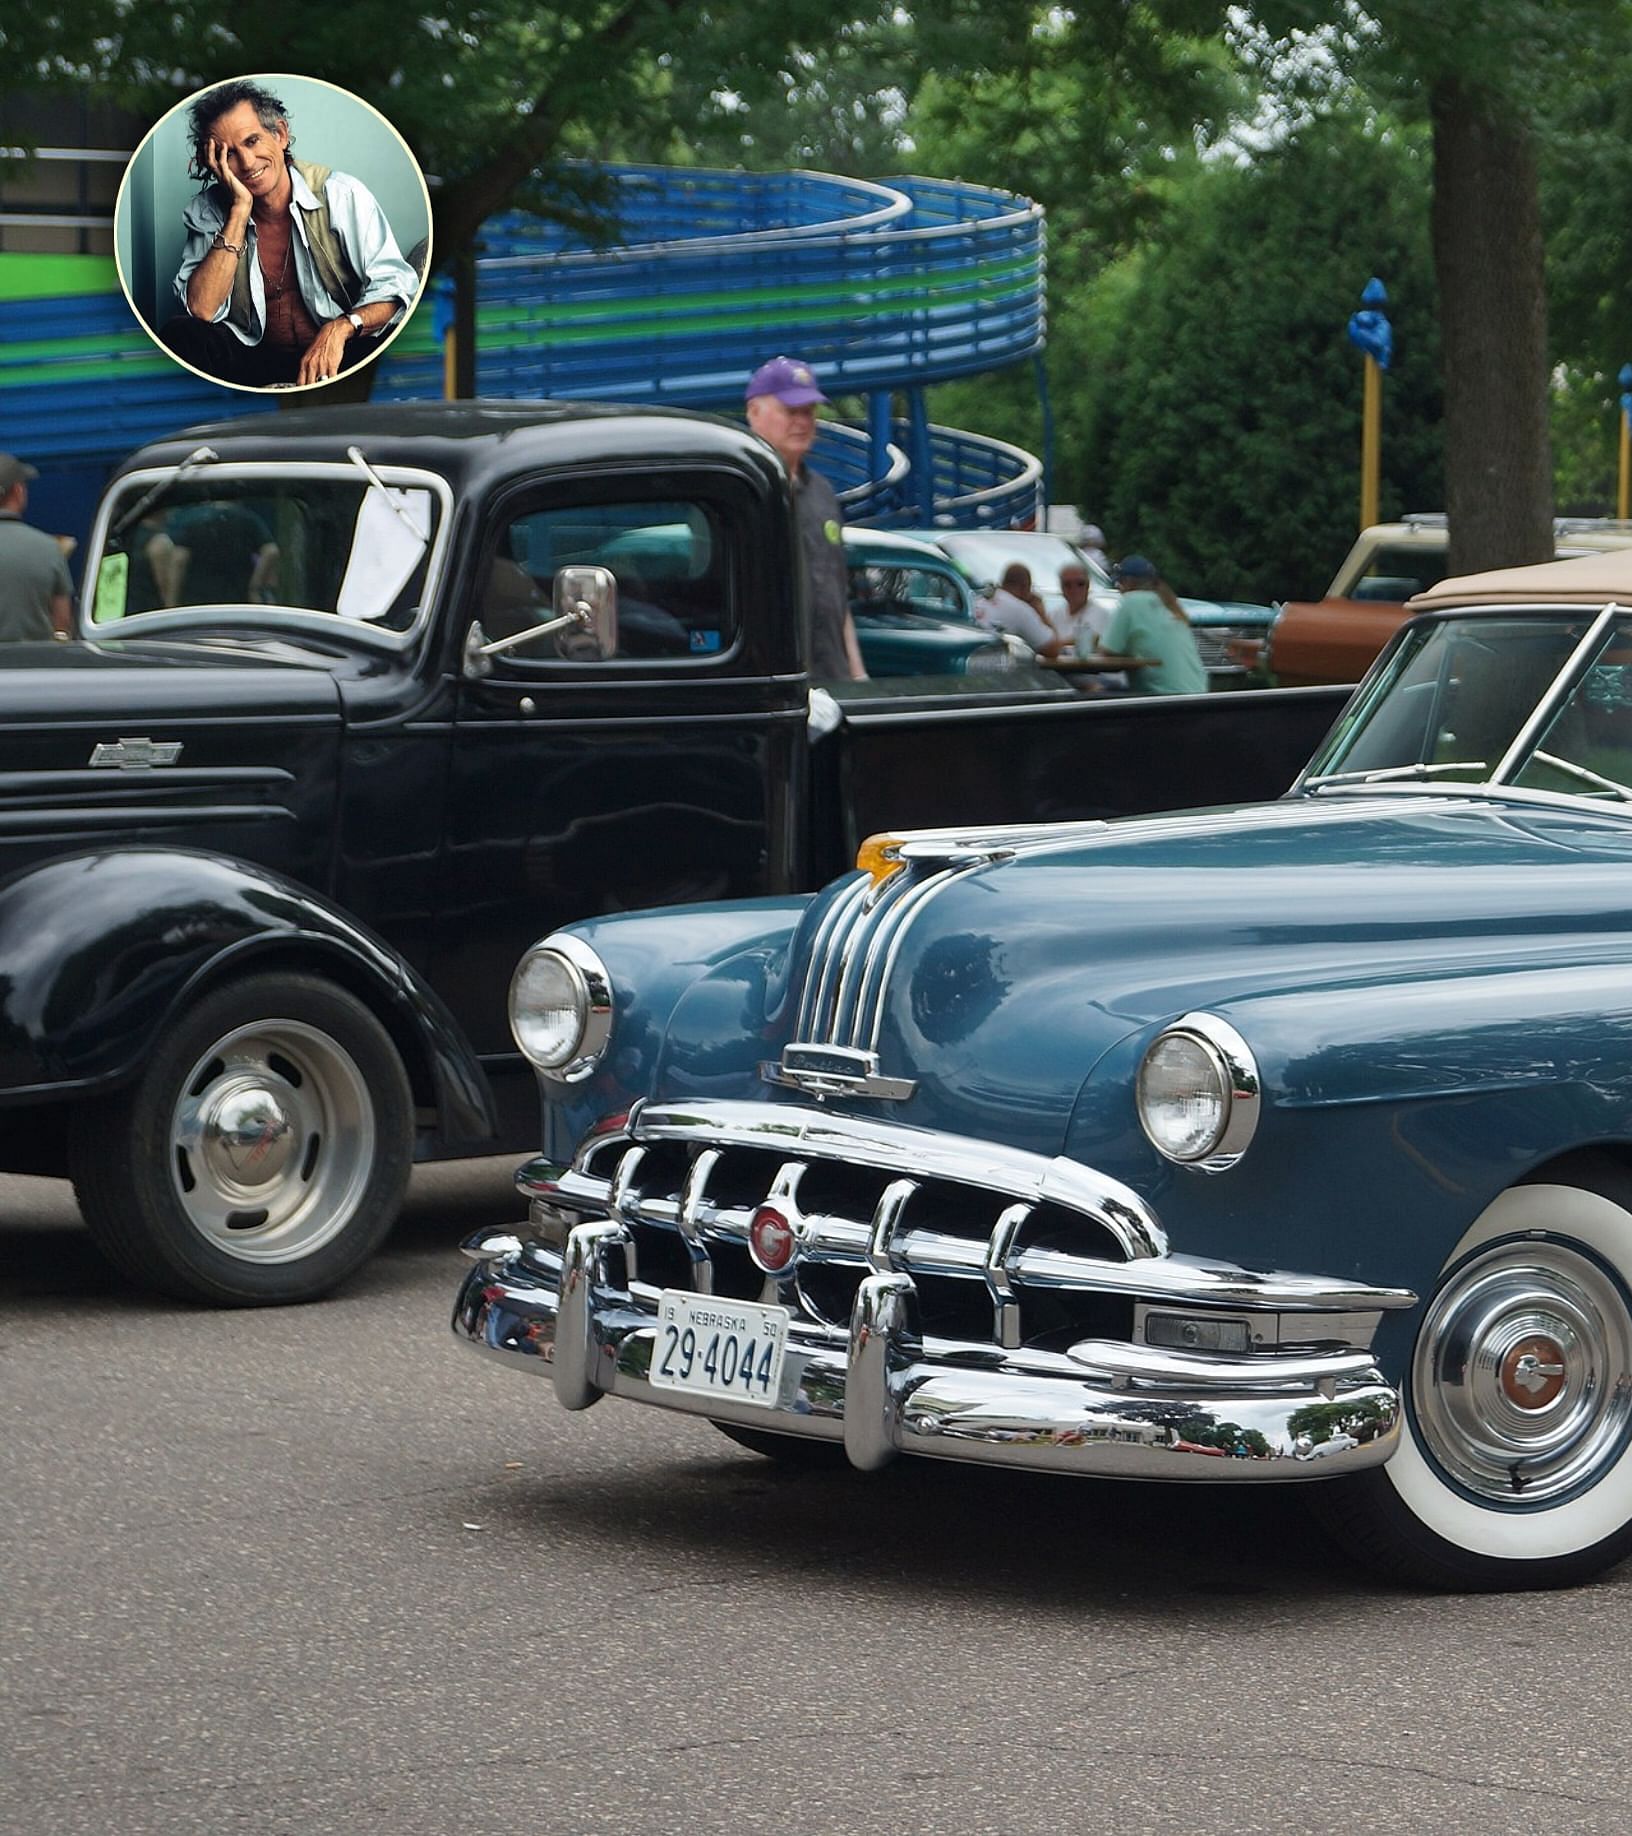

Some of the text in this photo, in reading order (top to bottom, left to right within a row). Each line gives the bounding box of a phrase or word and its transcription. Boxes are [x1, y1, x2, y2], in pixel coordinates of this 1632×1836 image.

[664, 1306, 777, 1337] 19 NEBRASKA 50
